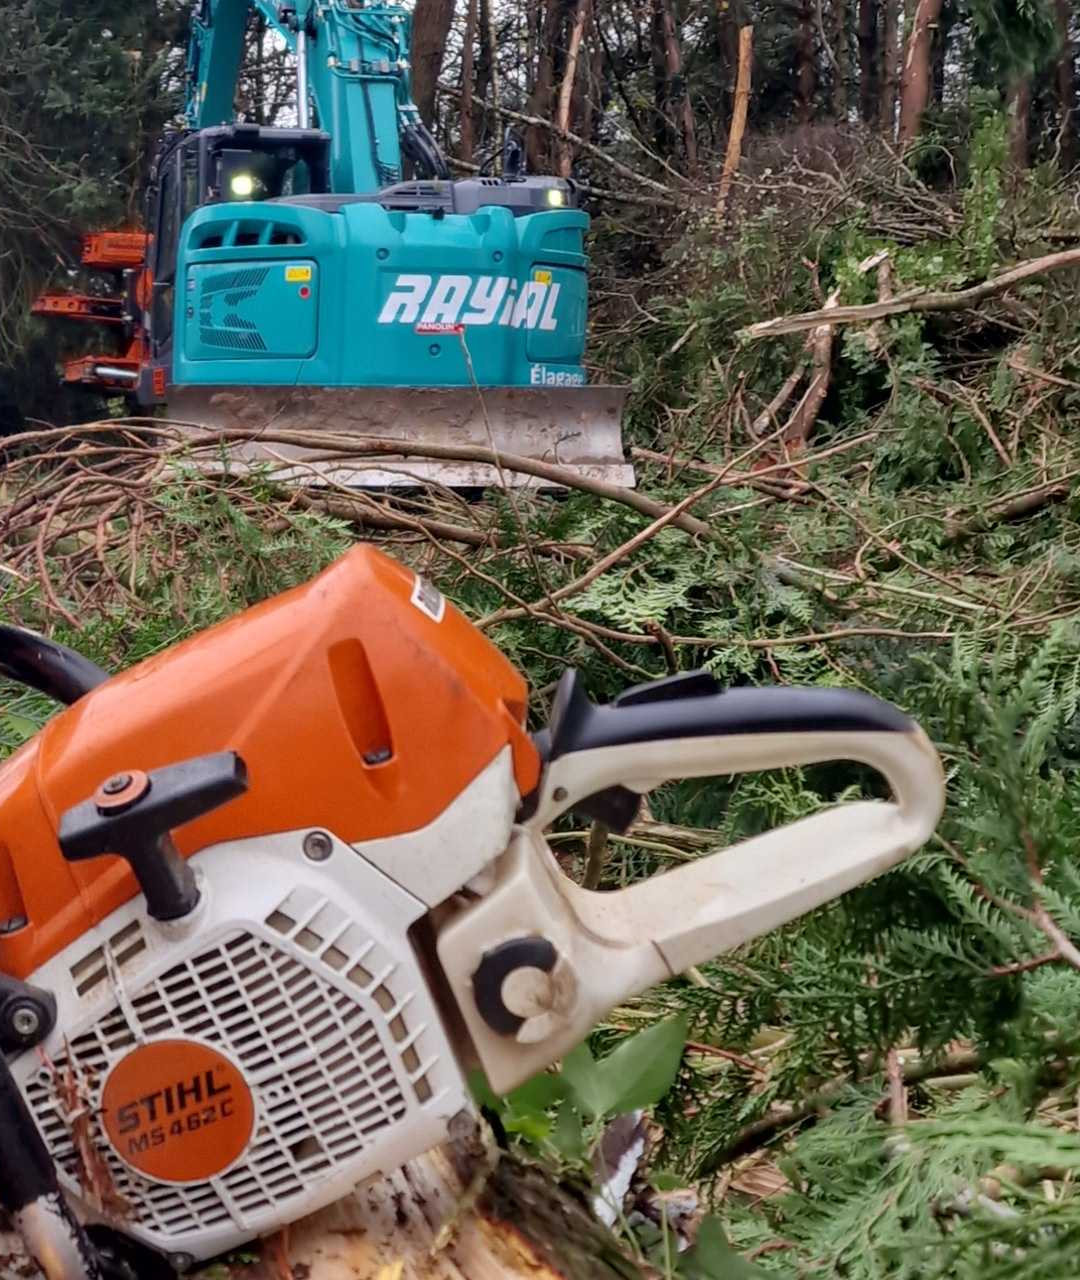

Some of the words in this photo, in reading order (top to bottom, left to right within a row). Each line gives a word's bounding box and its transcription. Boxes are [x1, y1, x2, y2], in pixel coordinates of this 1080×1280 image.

[118, 1070, 231, 1134] STIHL
[128, 1125, 165, 1155] MS
[170, 1105, 217, 1136] 462
[220, 1097, 235, 1119] C
